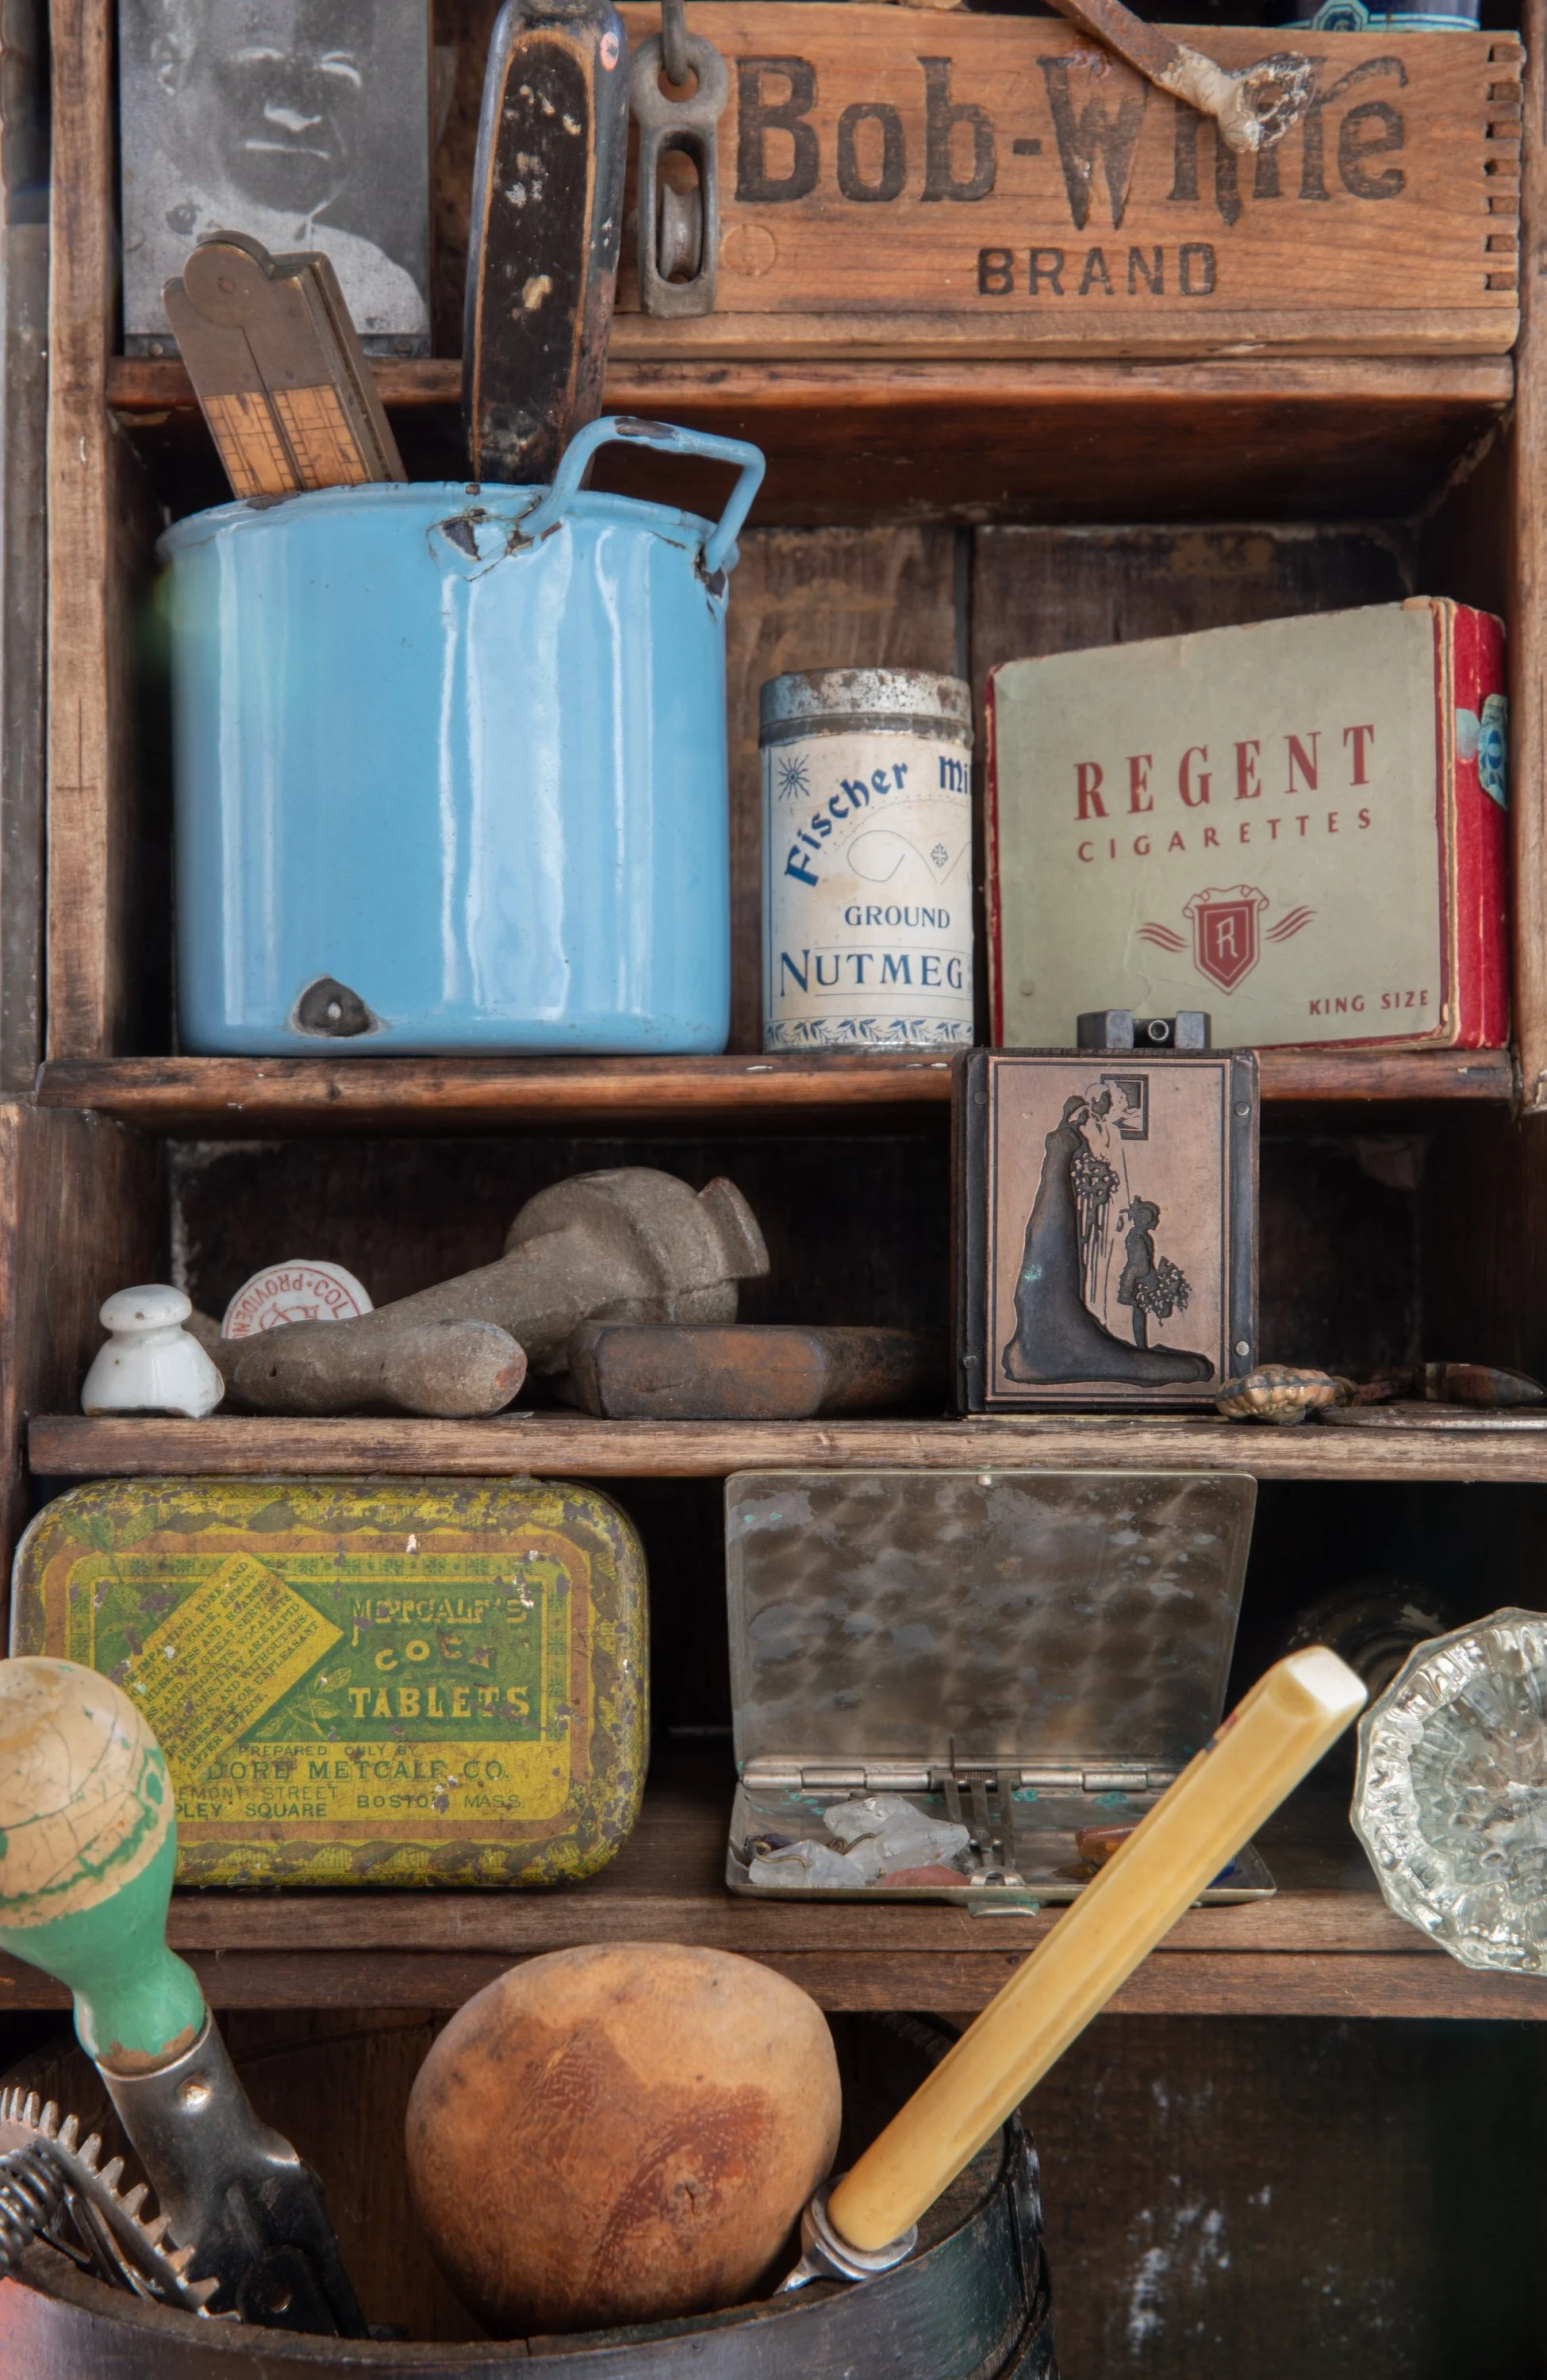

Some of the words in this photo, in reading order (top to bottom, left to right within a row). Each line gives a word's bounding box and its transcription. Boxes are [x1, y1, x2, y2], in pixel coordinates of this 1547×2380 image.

[977, 243, 1215, 297] BRAND
[1073, 724, 1374, 820] REGENT
[784, 761, 908, 888] Fischer
[939, 755, 973, 795] Mi
[1077, 808, 1372, 862] CIGARETTES
[845, 905, 950, 929] GROUND
[780, 949, 963, 997] NUTMEG
[1309, 994, 1365, 1015] KING
[1381, 990, 1429, 1009] SIZE
[195, 1585, 225, 1614] TONE
[227, 1560, 249, 1583] AND
[162, 1681, 184, 1704] AND
[184, 1665, 200, 1681] OF
[201, 1629, 236, 1665] GREAT
[236, 1586, 280, 1630] SERVICE
[236, 1592, 292, 1647] VOCALISTS
[246, 1633, 270, 1656] ARE
[268, 1602, 301, 1634] RAPID
[144, 1646, 201, 1702] HUSKIESS
[200, 1624, 223, 1647] AND
[146, 1665, 162, 1682] TO
[161, 1644, 184, 1667] TE
[218, 1679, 241, 1702] AND
[240, 1633, 289, 1681] WITHOUT
[175, 1701, 237, 1764] AGREEABLE
[236, 1685, 254, 1702] OR
[253, 1620, 320, 1686] UNPLEASANT
[348, 1686, 529, 1718] TABLETS
[188, 1734, 223, 1770] AFTER
[239, 1745, 327, 1756] PREPARED
[344, 1745, 385, 1756] ONLY
[397, 1745, 417, 1756] BY
[309, 1760, 447, 1779] METCALF
[463, 1760, 509, 1779] CO.
[244, 1802, 328, 1818] SQUARE
[263, 1786, 338, 1800] STREET
[357, 1795, 444, 1809] BOSTO
